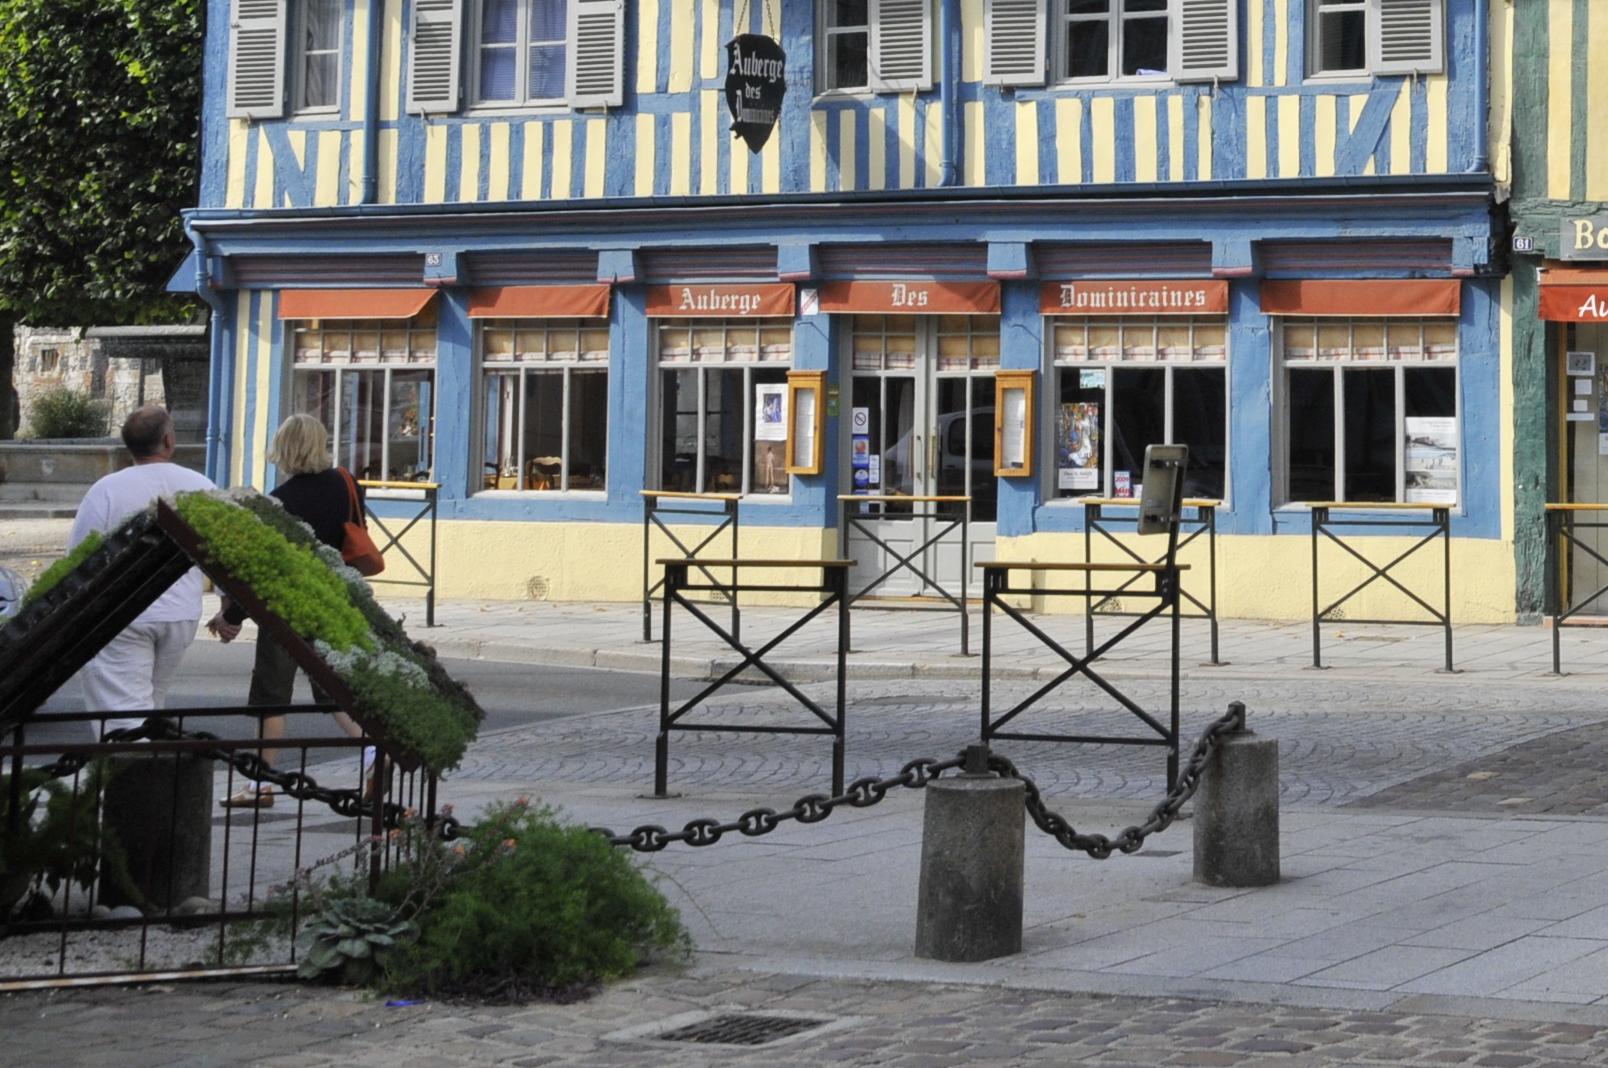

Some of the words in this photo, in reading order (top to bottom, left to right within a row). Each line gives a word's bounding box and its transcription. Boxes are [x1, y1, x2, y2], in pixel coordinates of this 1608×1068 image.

[729, 43, 783, 83] Auberge
[745, 82, 761, 100] des
[1516, 238, 1529, 249] 61
[427, 254, 440, 265] 63
[678, 287, 762, 315] Auberge
[891, 283, 928, 307] Des
[1060, 284, 1206, 308] Dominicaines
